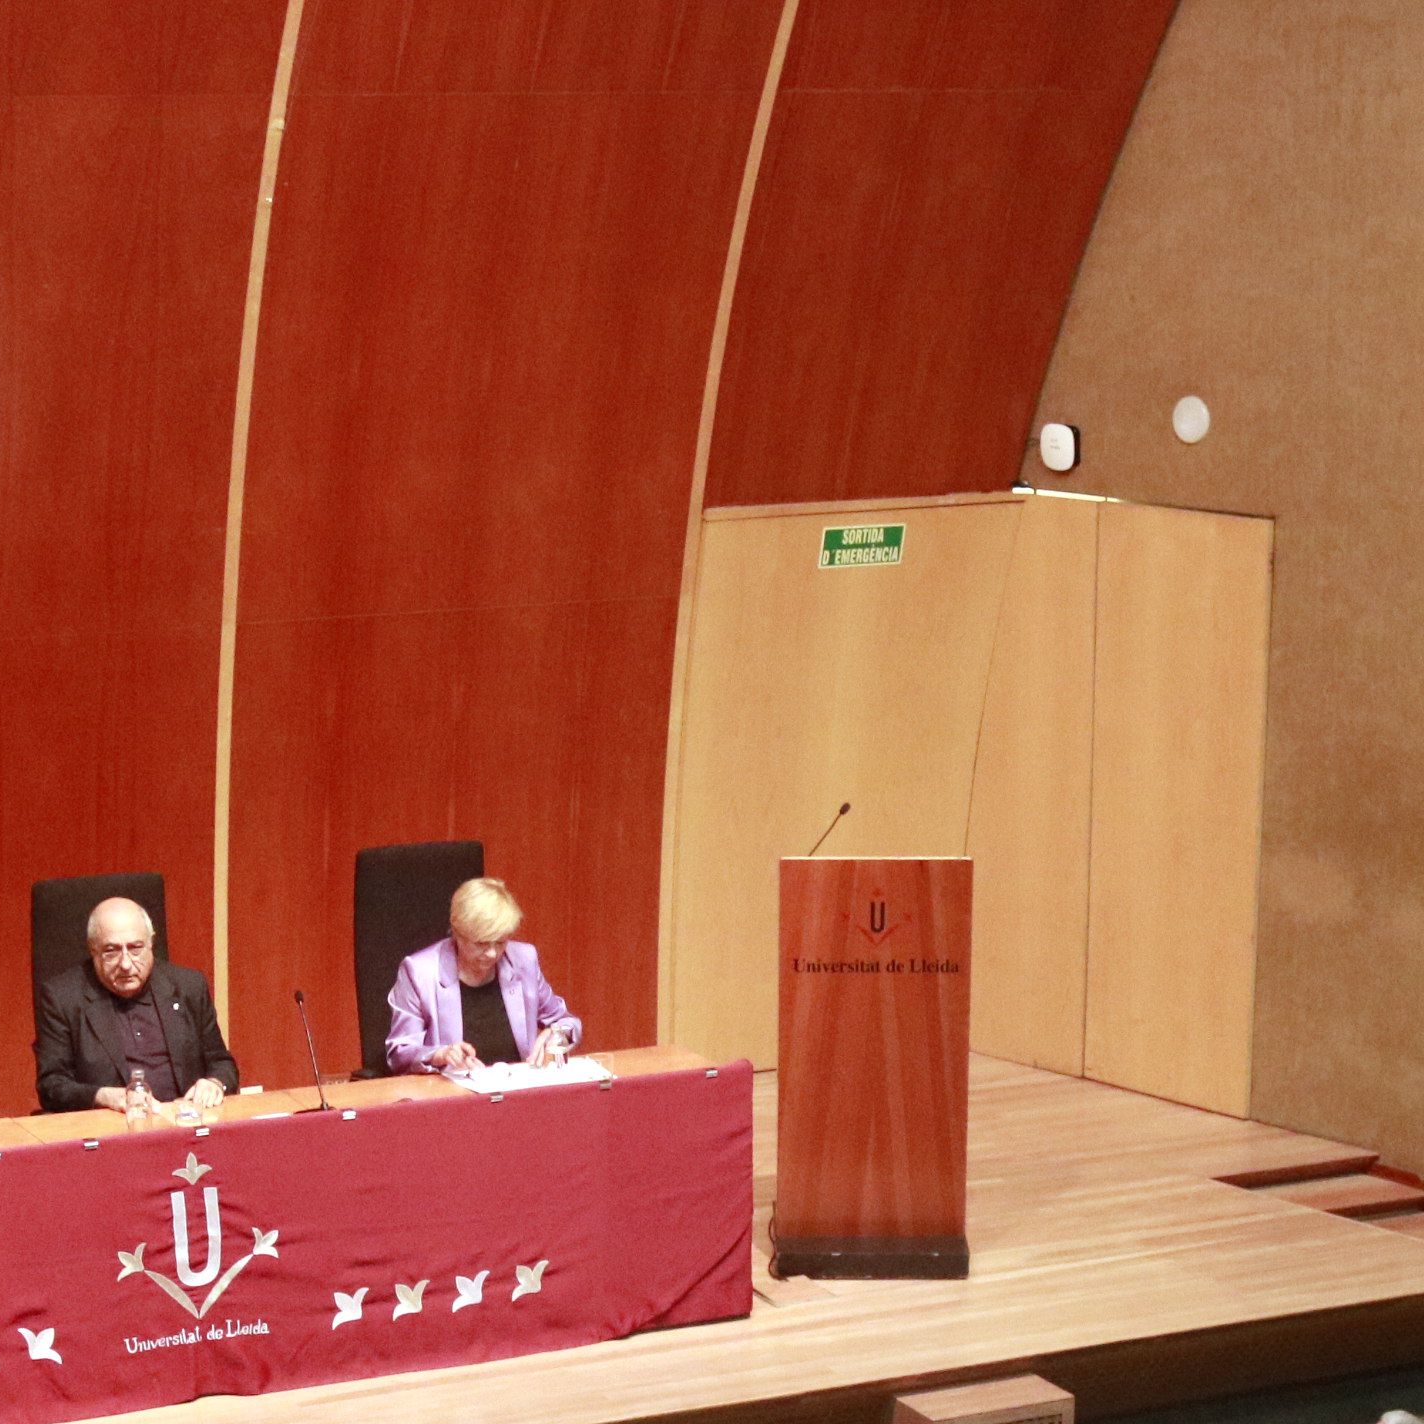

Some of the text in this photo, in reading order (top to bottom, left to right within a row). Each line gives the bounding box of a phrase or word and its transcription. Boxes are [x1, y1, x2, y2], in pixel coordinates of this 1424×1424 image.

[842, 527, 884, 545] SORTIDA
[868, 902, 886, 933] U
[792, 957, 960, 974] Universitat de Lleida
[171, 1187, 222, 1287] U
[124, 1318, 270, 1356] Universitat de Lleida
